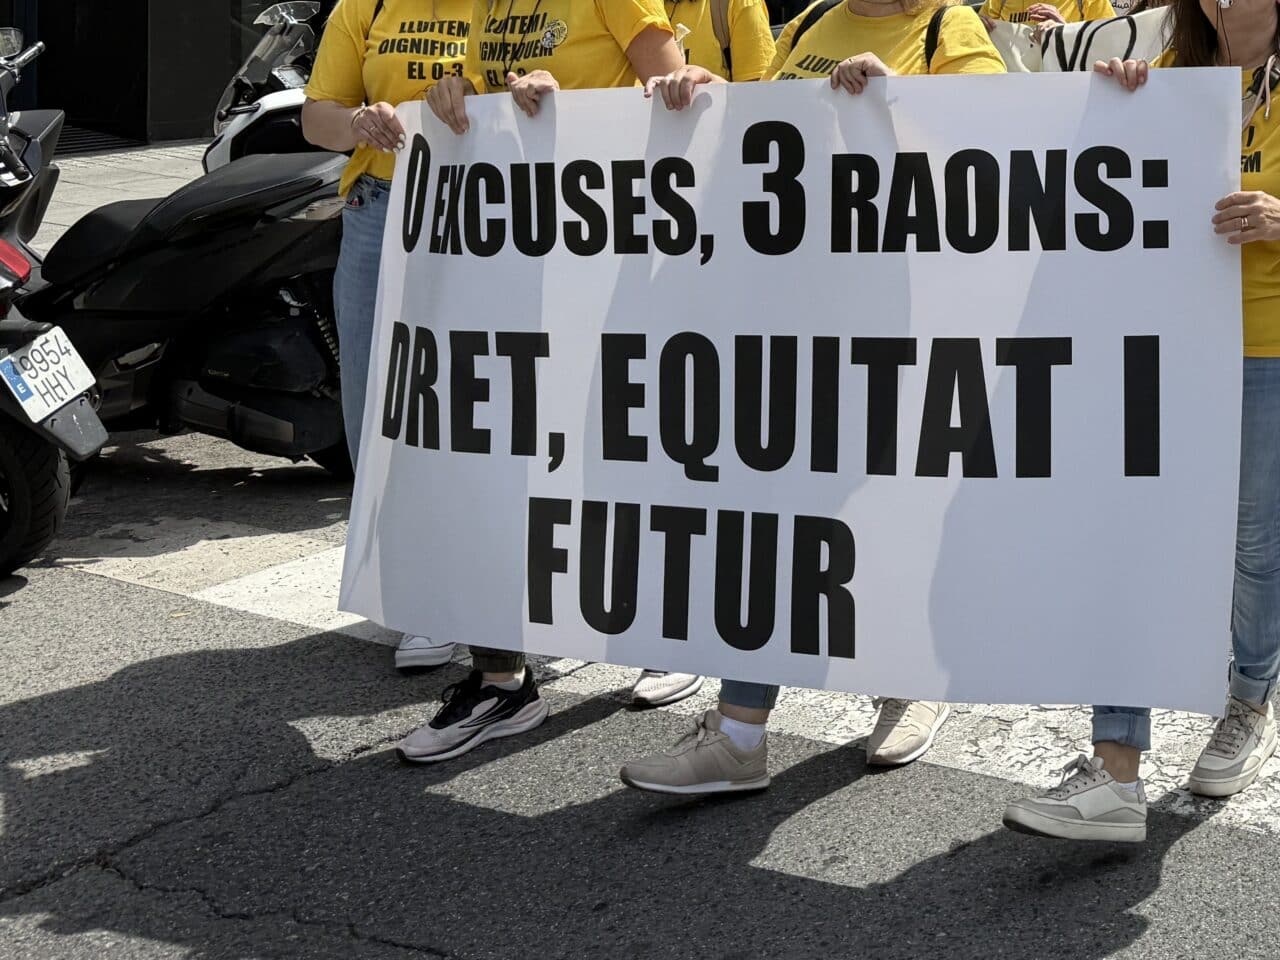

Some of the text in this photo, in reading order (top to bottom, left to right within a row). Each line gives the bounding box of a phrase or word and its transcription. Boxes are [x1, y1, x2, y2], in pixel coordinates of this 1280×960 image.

[408, 61, 426, 80] EL
[402, 120, 1170, 266] 0 EXCUSES, 3 RAONS:
[19, 334, 72, 379] 9954
[34, 365, 75, 408] HHY
[381, 321, 1161, 483] DRET, EQUITAT I
[527, 496, 857, 659] FUTUR
